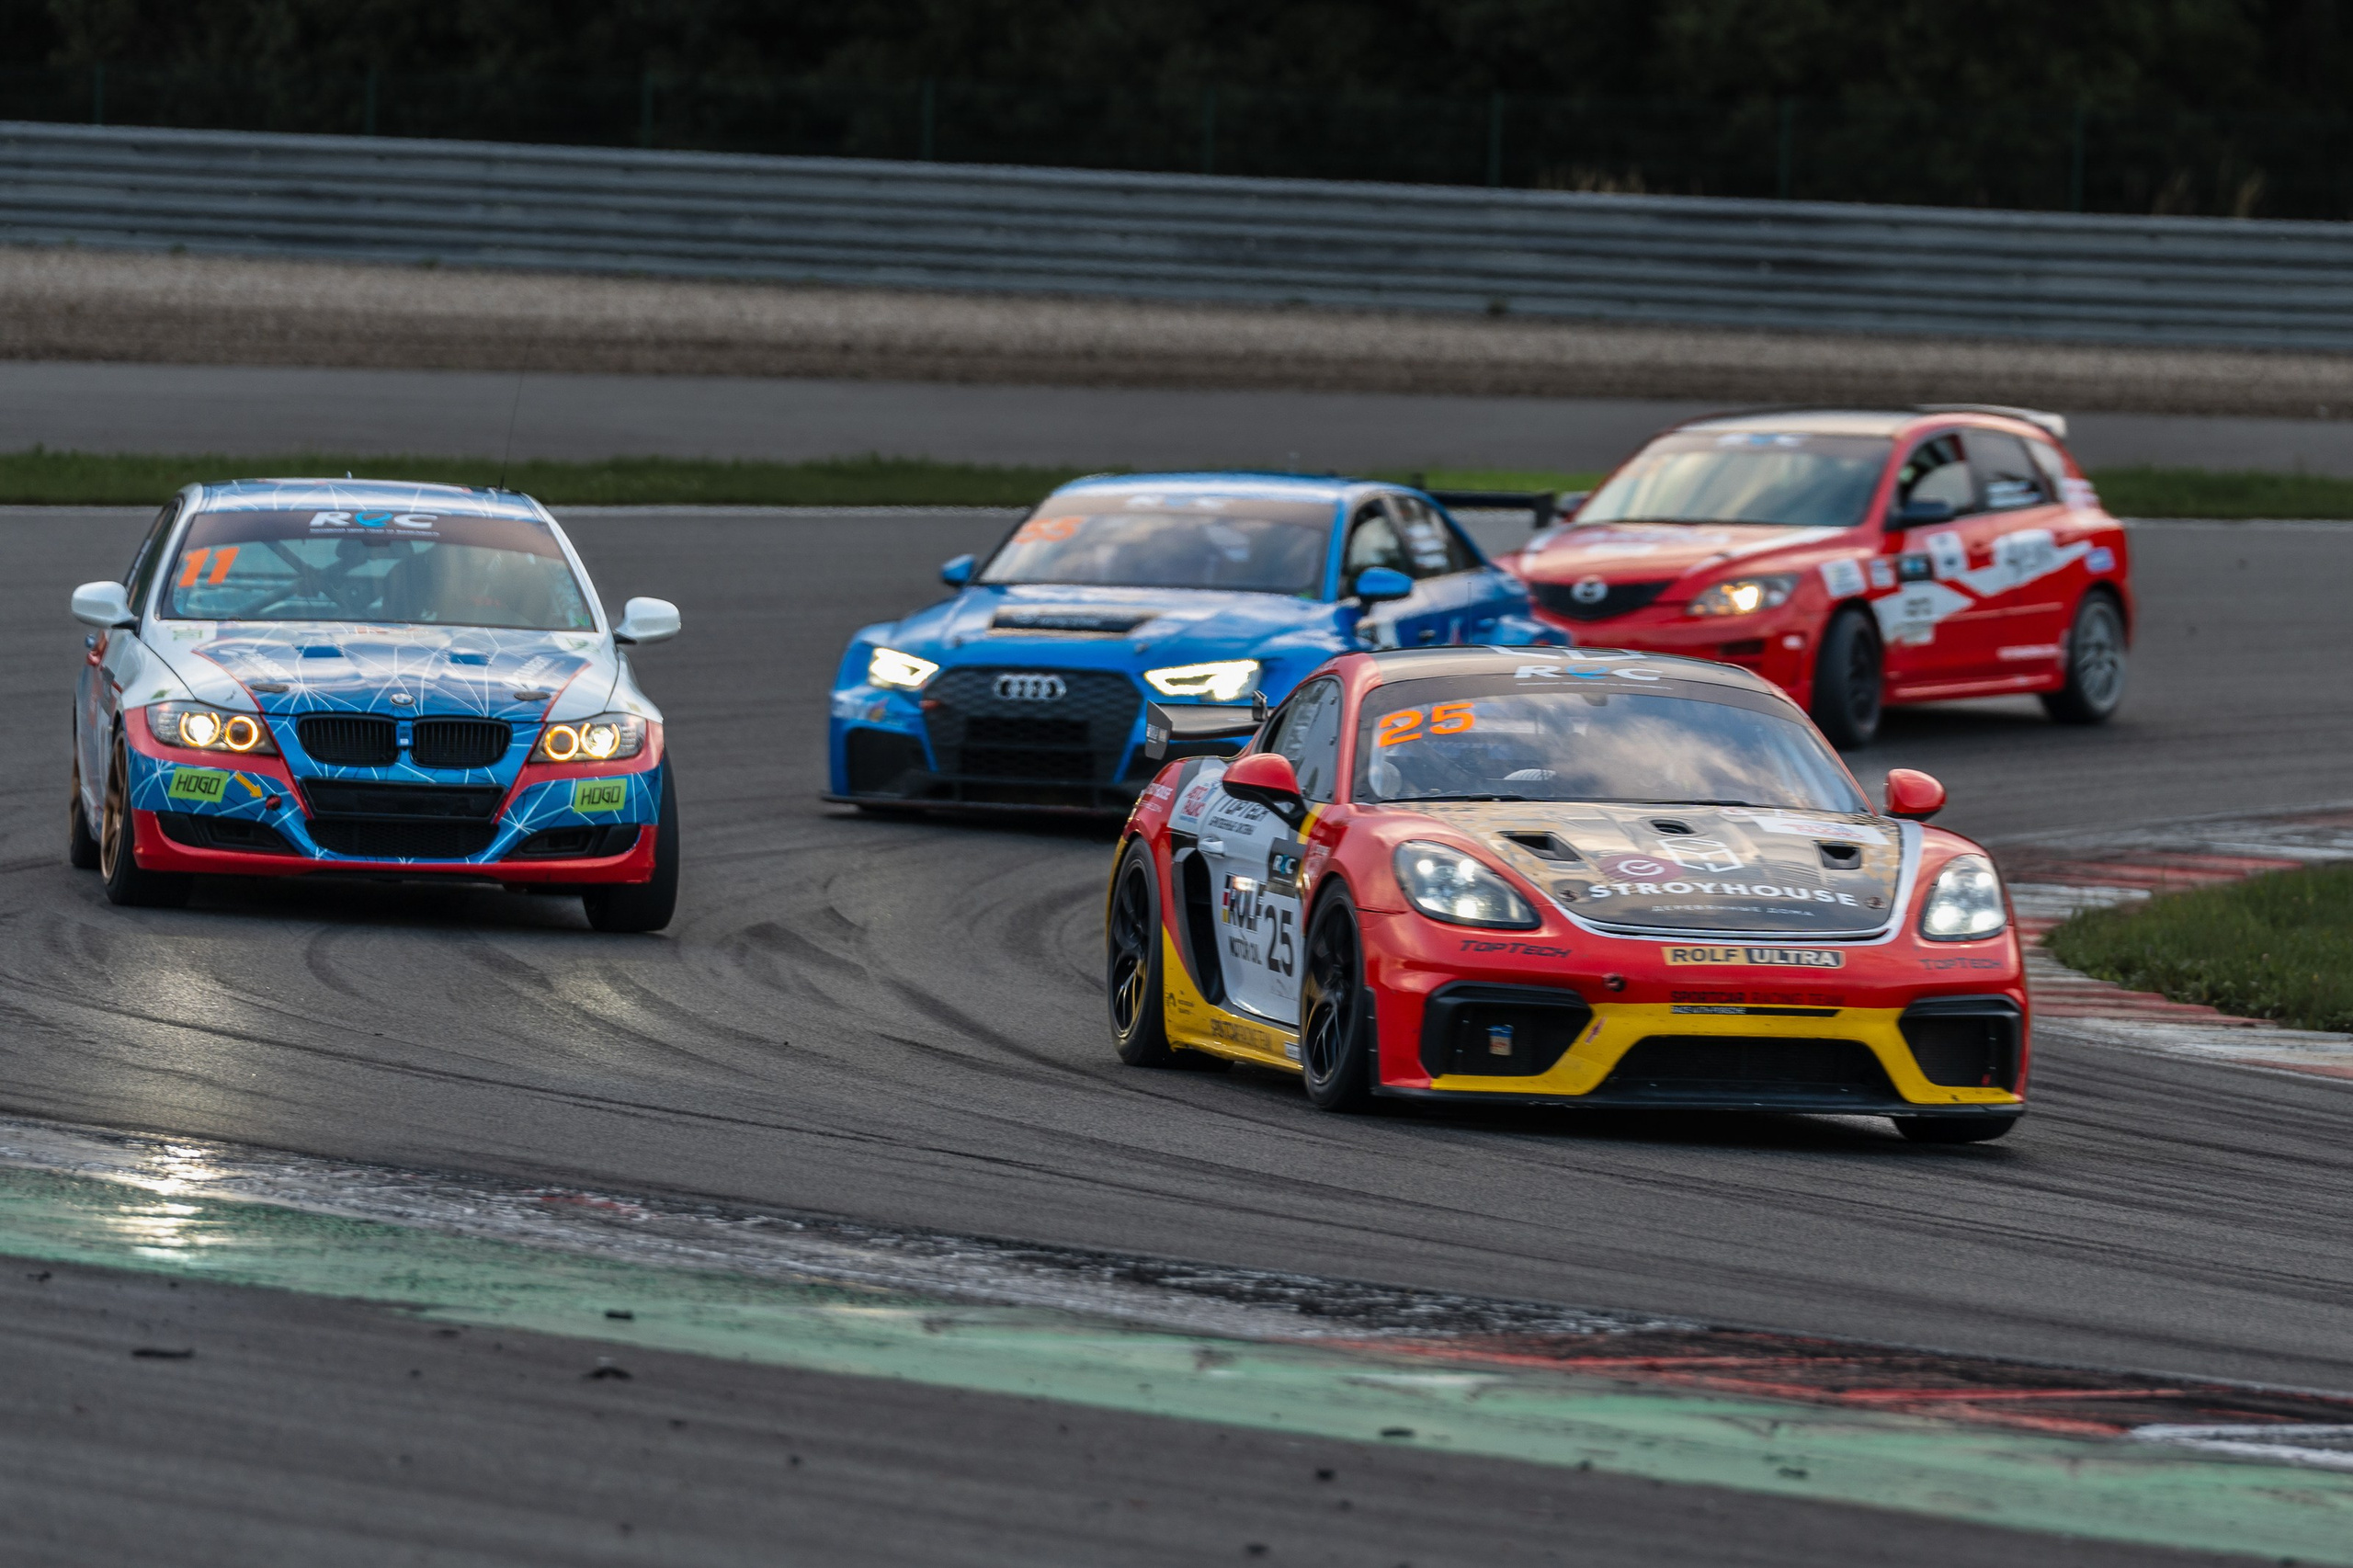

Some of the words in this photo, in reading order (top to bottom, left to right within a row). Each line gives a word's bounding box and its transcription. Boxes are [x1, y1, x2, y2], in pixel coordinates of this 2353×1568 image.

[178, 546, 239, 588] 11
[1378, 702, 1475, 747] 25
[175, 774, 222, 796] HOGO
[579, 785, 621, 806] HOGO
[1588, 881, 1859, 907] STROYHOUSE
[1265, 904, 1295, 978] 25
[1671, 948, 1739, 962] ROLF
[1750, 949, 1837, 966] ULTRA
